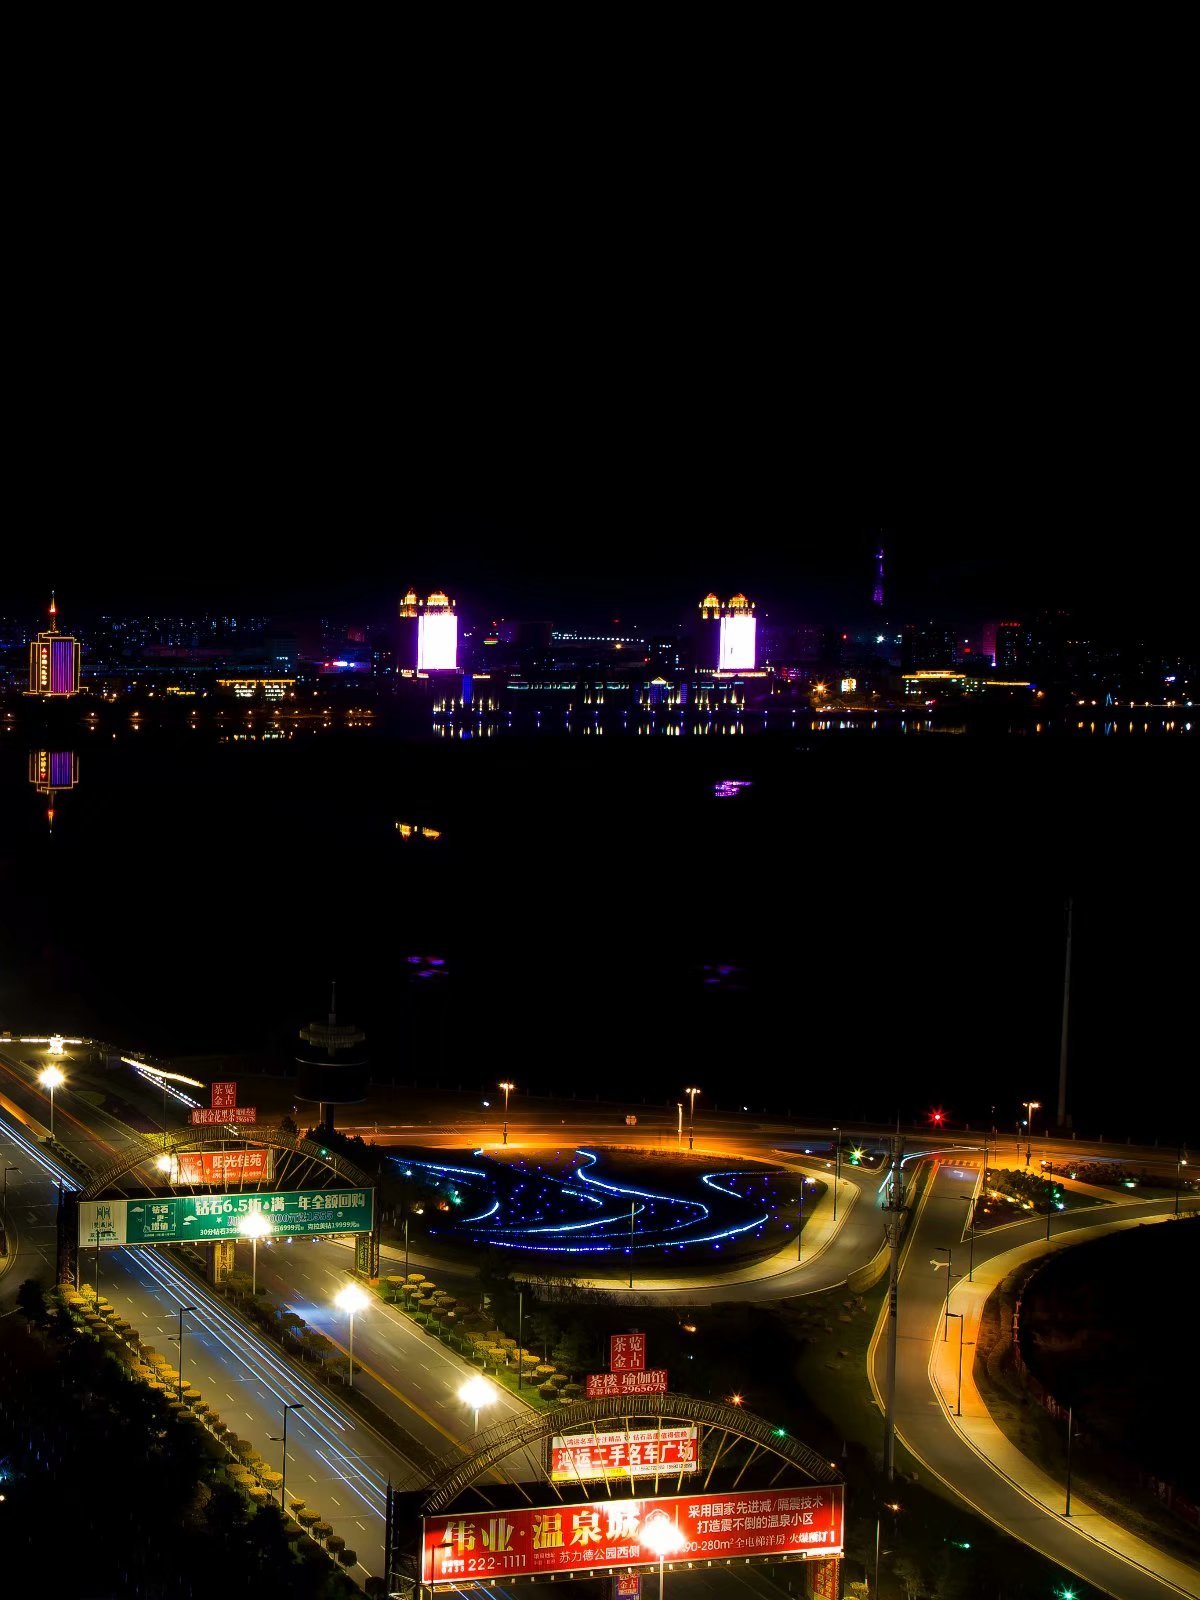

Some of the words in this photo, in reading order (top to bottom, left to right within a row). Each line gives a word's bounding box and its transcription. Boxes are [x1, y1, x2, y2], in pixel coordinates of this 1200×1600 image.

[212, 1154, 262, 1168] 阳光佳苑
[270, 1193, 366, 1212] 满一年全额回购
[590, 1374, 618, 1388] 茶楼
[621, 1371, 666, 1385] 瑜伽馆
[622, 1383, 666, 1394] 2965678
[557, 1441, 694, 1469] 鸿运二手名车广场
[688, 1495, 824, 1519] 采用国家先进减/隔震技术
[697, 1512, 814, 1535] 打造震不倒的温泉小区
[467, 1554, 527, 1572] 222-1111
[559, 1545, 640, 1564] 苏力德公园西侧
